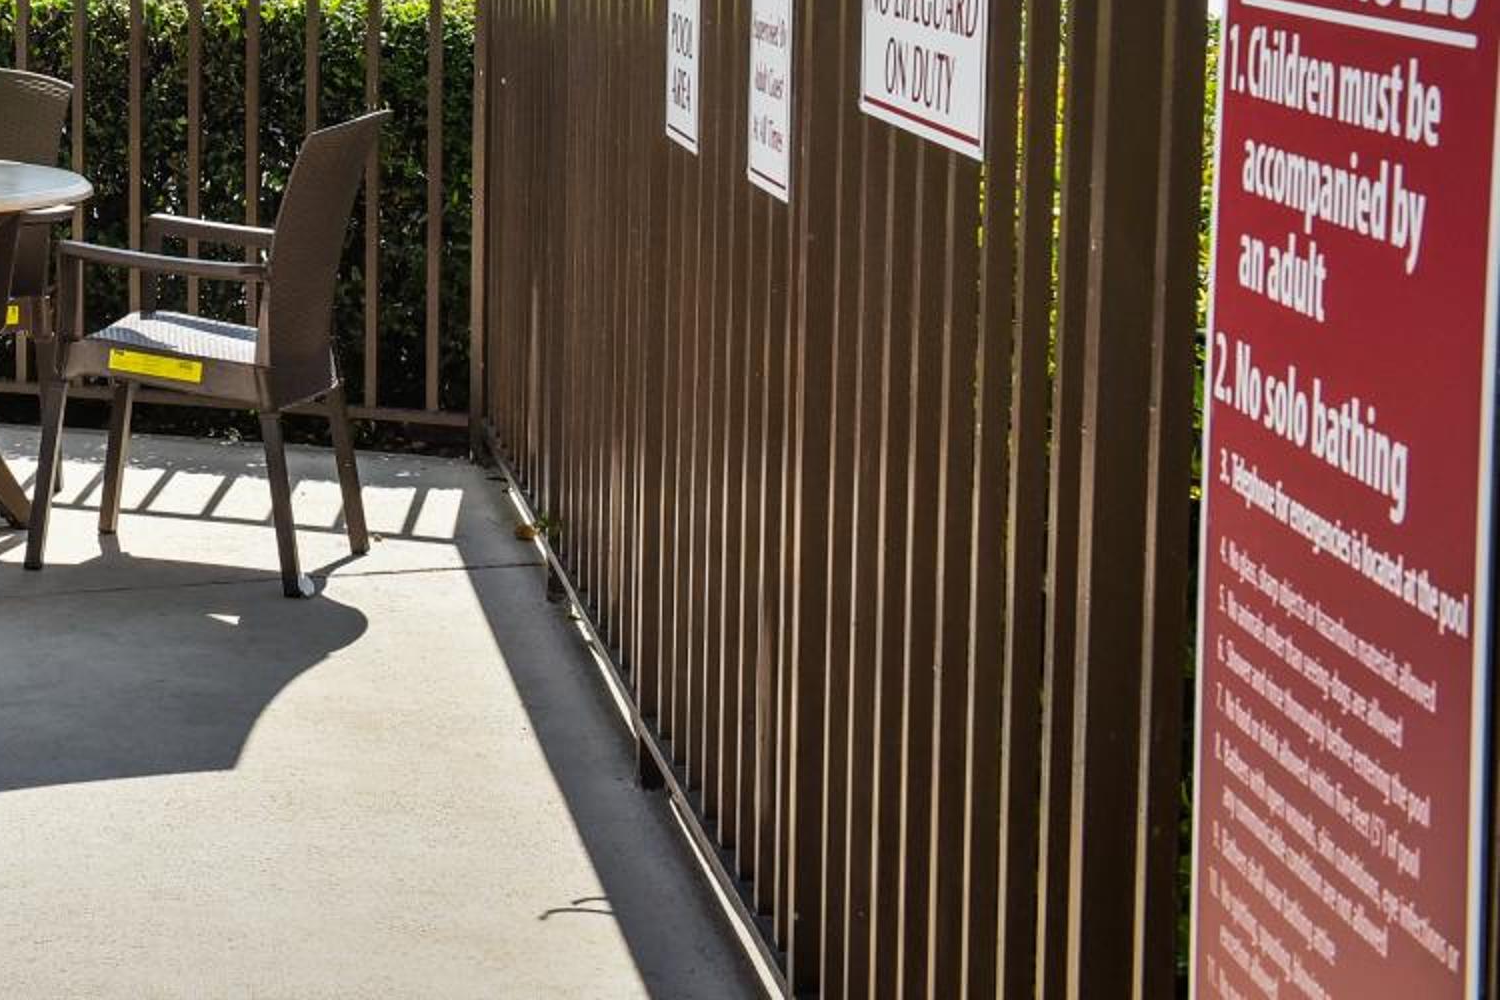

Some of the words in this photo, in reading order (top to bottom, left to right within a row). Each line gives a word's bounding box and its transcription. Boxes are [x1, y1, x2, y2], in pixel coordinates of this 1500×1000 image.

[672, 12, 693, 59] POOL
[884, 37, 908, 97] ON
[911, 45, 957, 116] DUTY
[1229, 24, 1245, 93] 1.
[1247, 27, 1335, 117] Children
[1338, 66, 1404, 136] must
[1405, 58, 1442, 147] be
[671, 65, 691, 114] AREA
[1242, 141, 1389, 239] accompanied
[1390, 165, 1426, 274] by
[1238, 235, 1265, 294] an
[1266, 234, 1327, 322] adult
[1214, 332, 1233, 401] 2.
[1234, 341, 1262, 420] No
[1263, 366, 1309, 447] solo
[1311, 380, 1408, 523] bathing
[1231, 453, 1276, 515] Telephone
[1274, 481, 1290, 524] for
[1289, 500, 1352, 564] emergencies
[1350, 530, 1362, 571] is
[1360, 534, 1404, 597] located
[1402, 569, 1418, 607] at
[1416, 570, 1439, 620] the
[1438, 592, 1469, 638] pool
